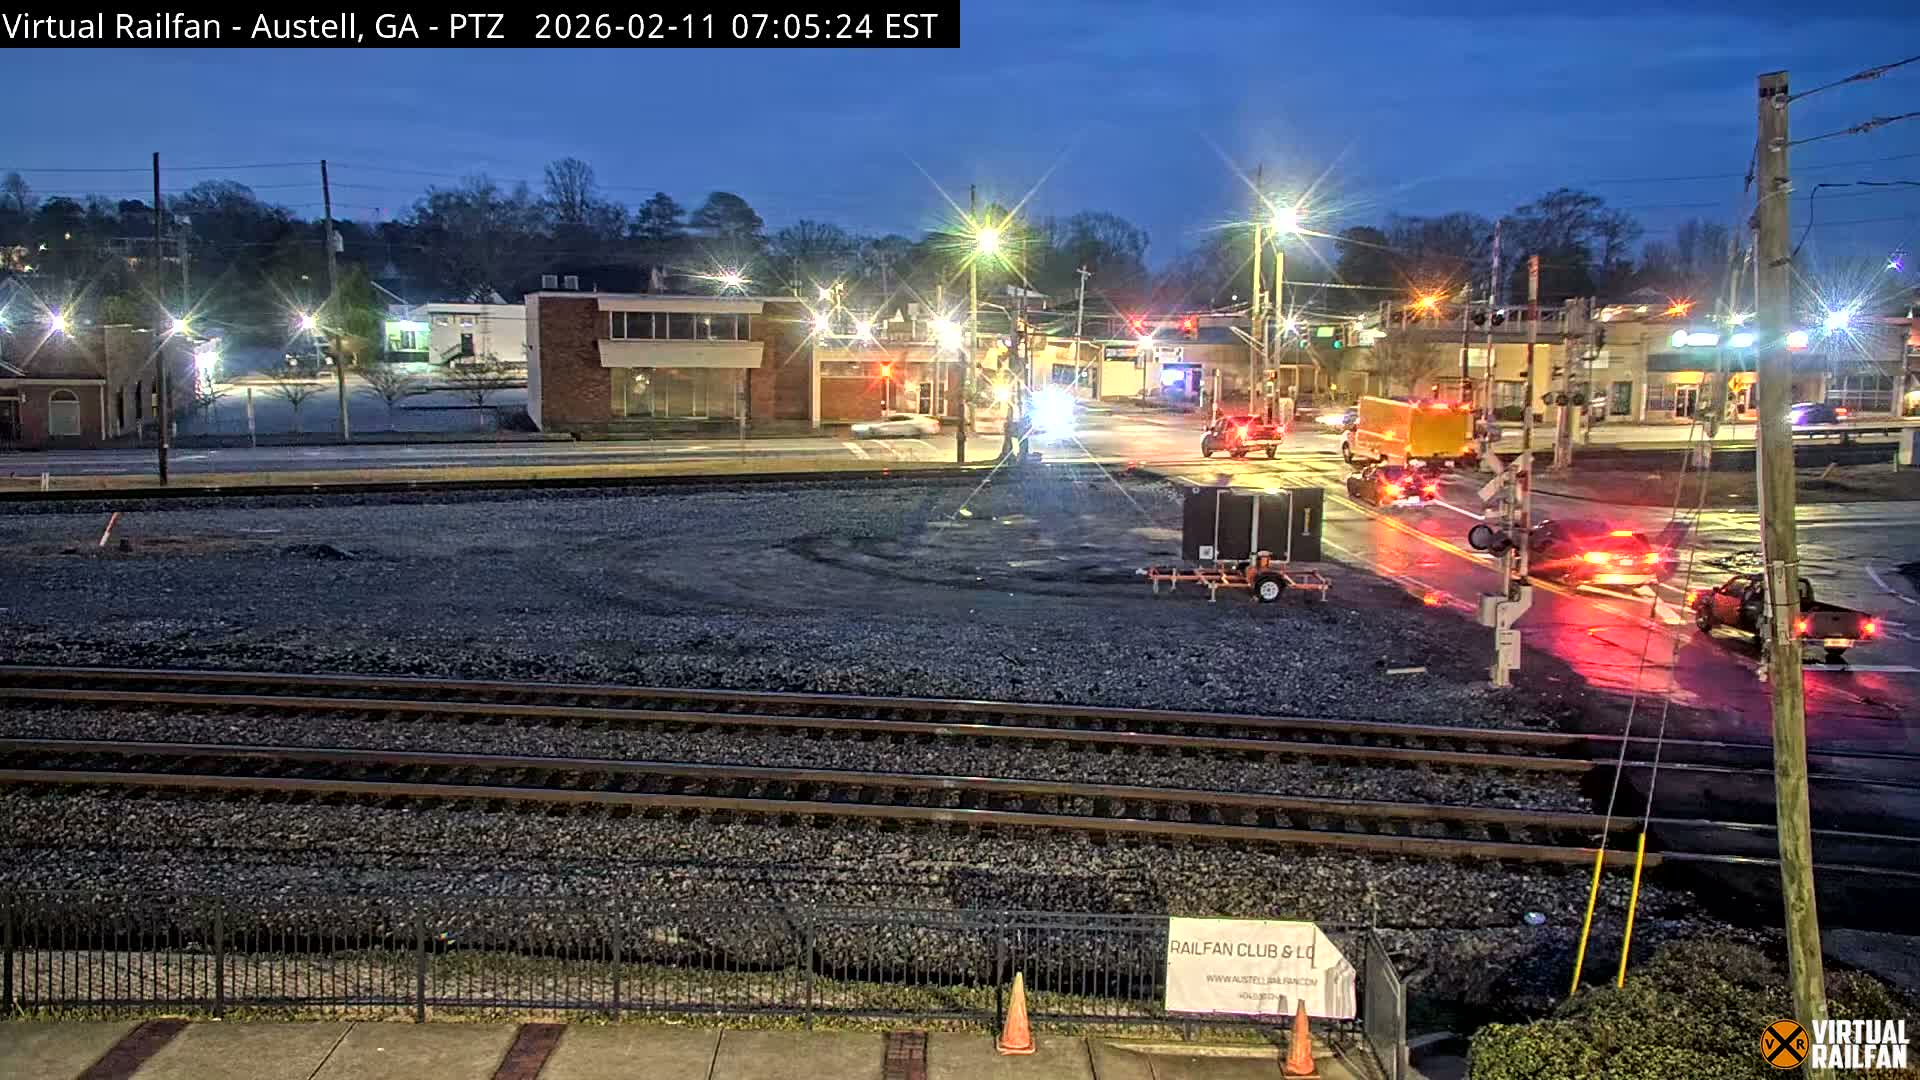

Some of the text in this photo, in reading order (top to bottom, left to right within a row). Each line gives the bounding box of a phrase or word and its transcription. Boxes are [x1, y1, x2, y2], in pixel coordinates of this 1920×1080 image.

[1170, 940, 1234, 957] RAILFAN
[1237, 943, 1278, 959] CLUB
[1281, 945, 1293, 959] &
